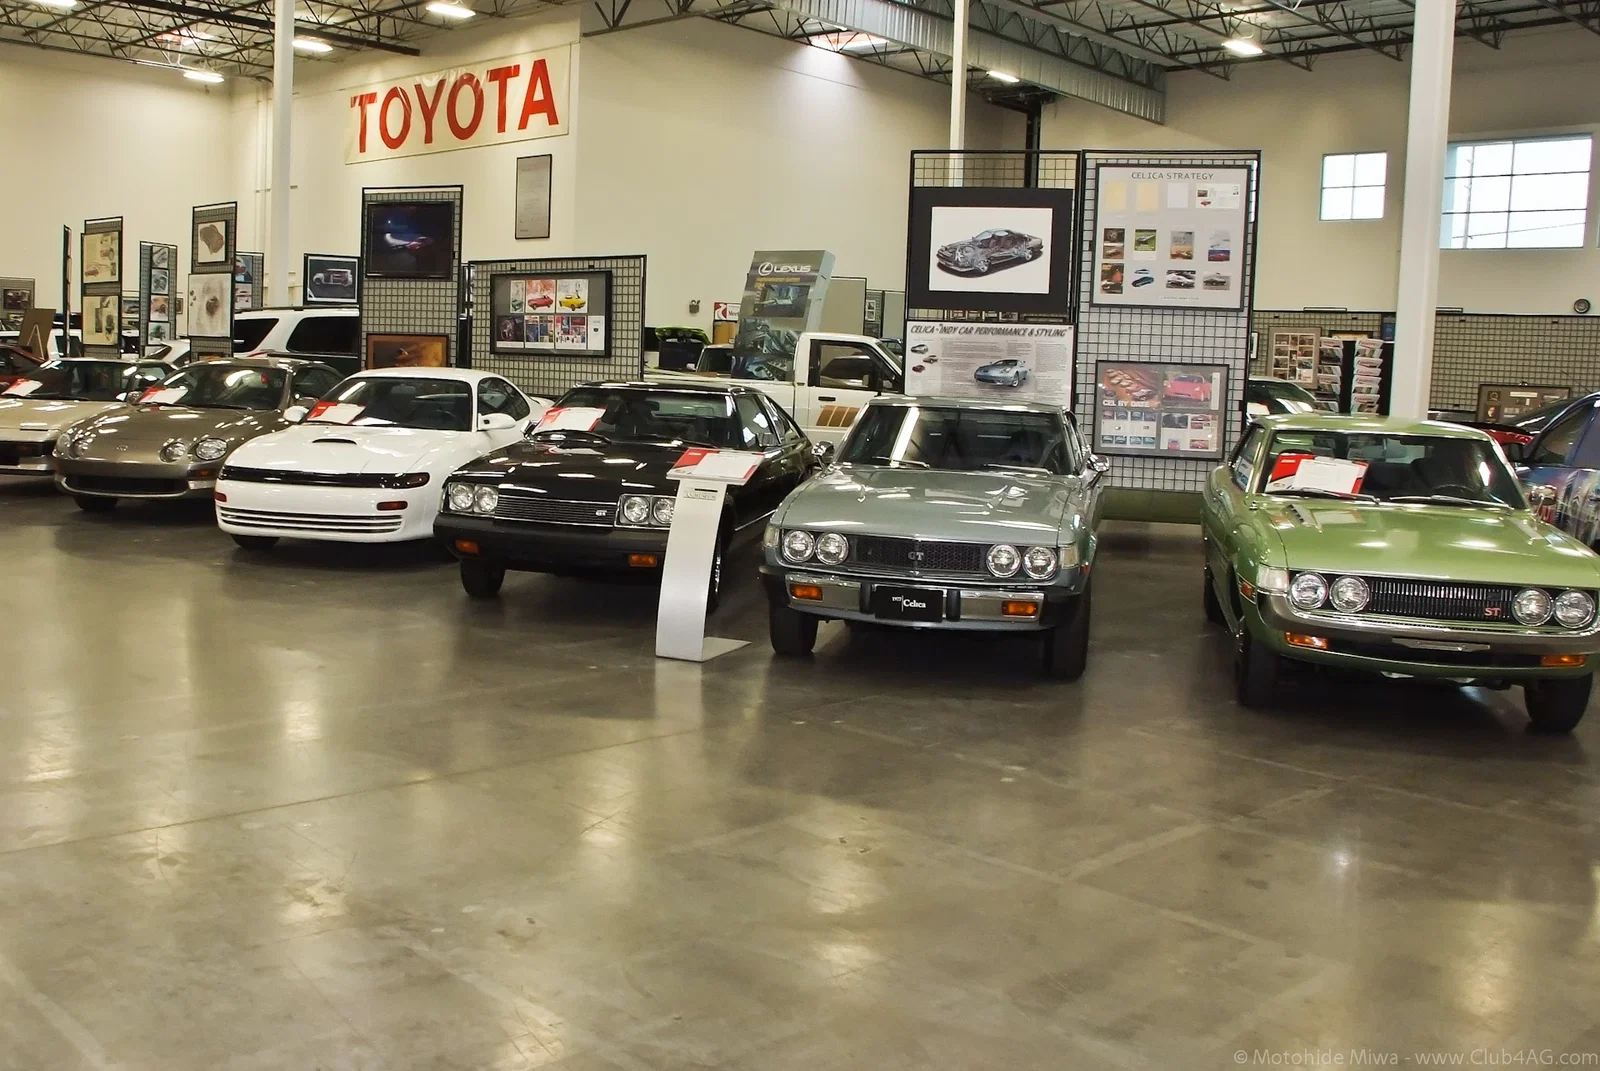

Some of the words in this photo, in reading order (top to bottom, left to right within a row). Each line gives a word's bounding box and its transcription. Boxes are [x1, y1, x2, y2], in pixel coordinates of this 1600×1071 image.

[350, 58, 560, 153] TOYOTA
[1166, 172, 1214, 180] STRATEGY
[773, 265, 811, 273] LEXUS
[910, 325, 935, 334] CELICA
[958, 326, 974, 335] CAR
[974, 326, 1028, 337] PERFORMANCE
[1028, 327, 1034, 337] &
[908, 551, 924, 560] GT
[903, 599, 926, 608] Celica
[1484, 607, 1501, 617] ST
